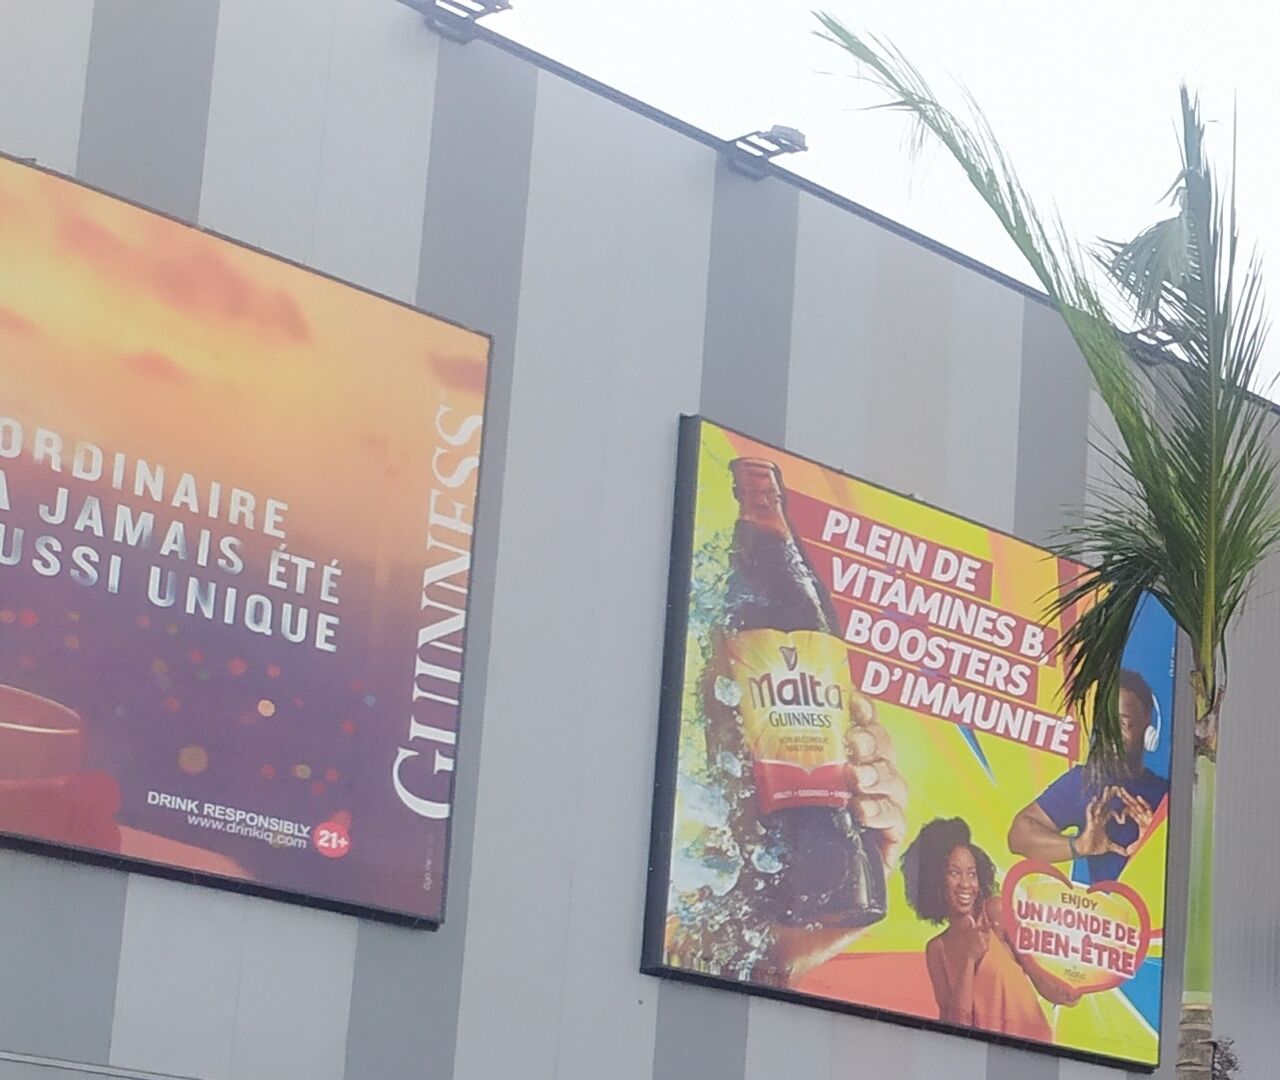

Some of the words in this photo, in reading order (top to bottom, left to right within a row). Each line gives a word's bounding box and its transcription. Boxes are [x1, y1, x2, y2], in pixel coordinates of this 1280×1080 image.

[0, 416, 289, 539] ORDINAIRE
[38, 487, 244, 575] JAMAIS
[267, 543, 343, 605] ÉTÉ
[822, 508, 928, 574] PLEIN
[931, 548, 982, 593] DE
[147, 566, 340, 652] UNIQUE
[393, 403, 484, 819] GUINNESS
[832, 556, 1017, 648] VITAMINES
[845, 608, 1032, 697] BOOSTERS
[748, 671, 844, 711] Malta
[769, 710, 832, 729] GUINNESS
[860, 660, 1075, 755] D'IMMUNITÉ
[147, 791, 200, 814] DRINK
[203, 803, 311, 839] RESPONSIBLY
[187, 813, 308, 849] www.drinkiq.com
[318, 829, 349, 849] 21+
[1017, 899, 1043, 922] UN
[1046, 905, 1112, 939] MONDE
[1114, 922, 1138, 947] DE
[1060, 892, 1099, 911] ENJOY
[1017, 925, 1136, 977] BIEN-ÊTRE
